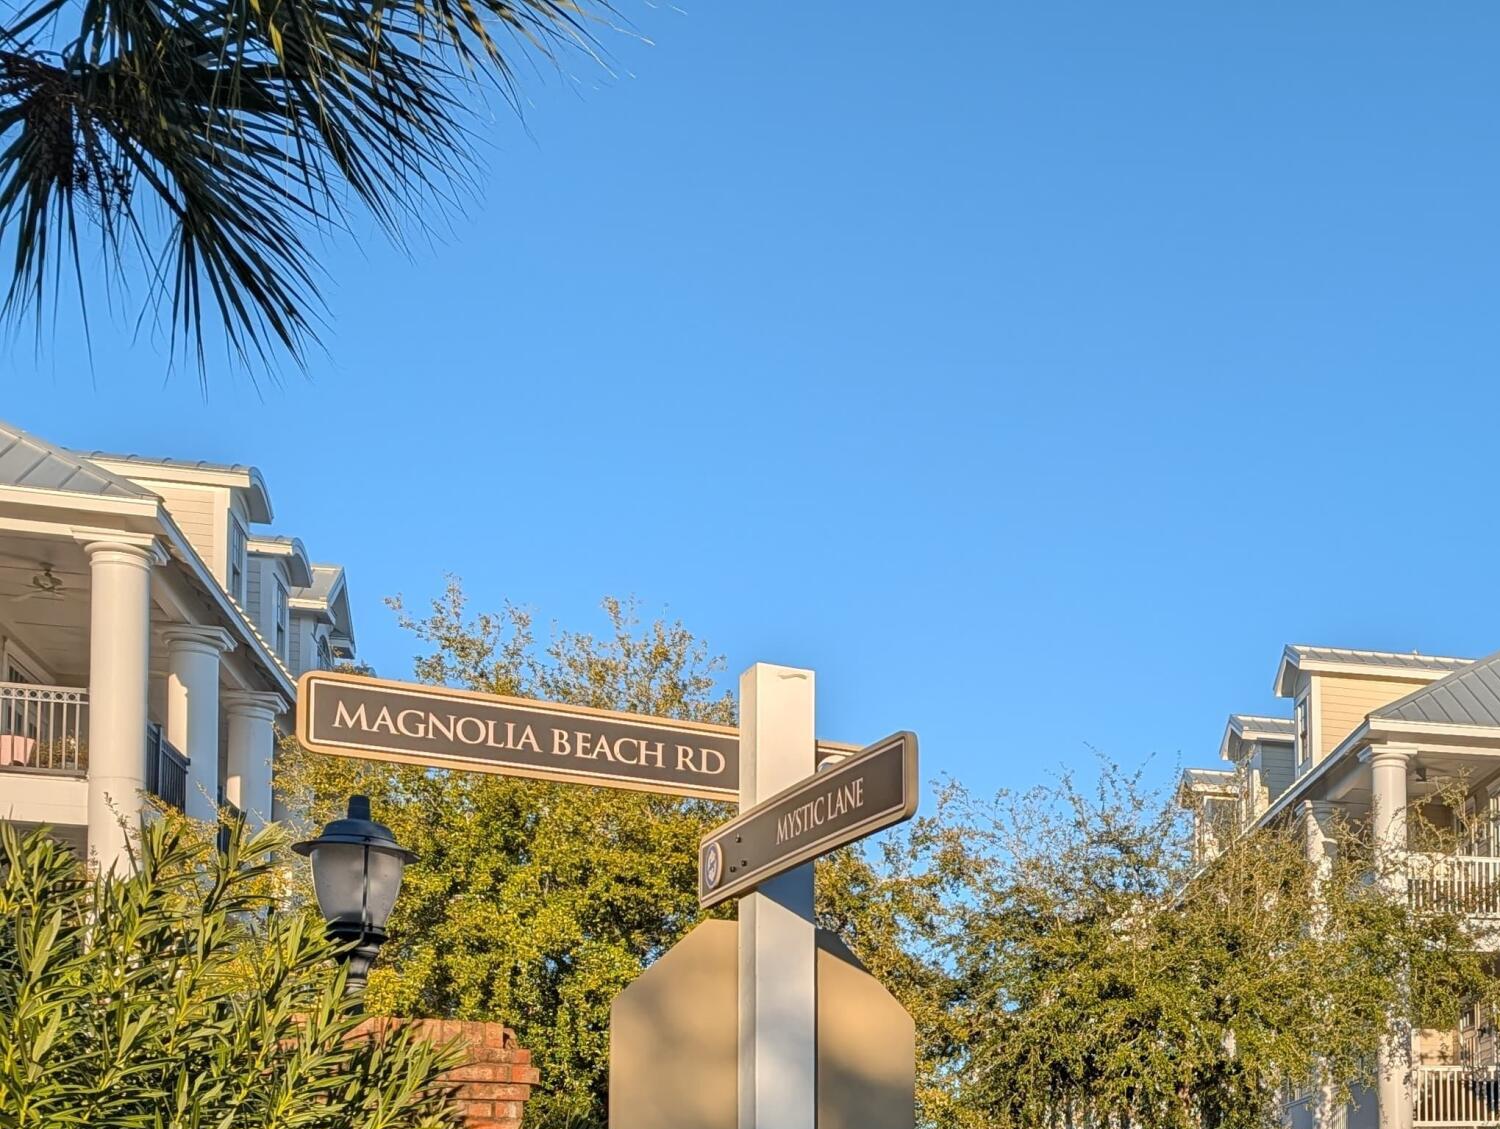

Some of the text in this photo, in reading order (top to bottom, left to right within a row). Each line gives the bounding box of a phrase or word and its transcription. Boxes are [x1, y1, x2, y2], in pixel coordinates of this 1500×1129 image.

[331, 700, 726, 775] MAGNOLIA BEACH RD
[775, 777, 864, 846] MYSTIC LANE
